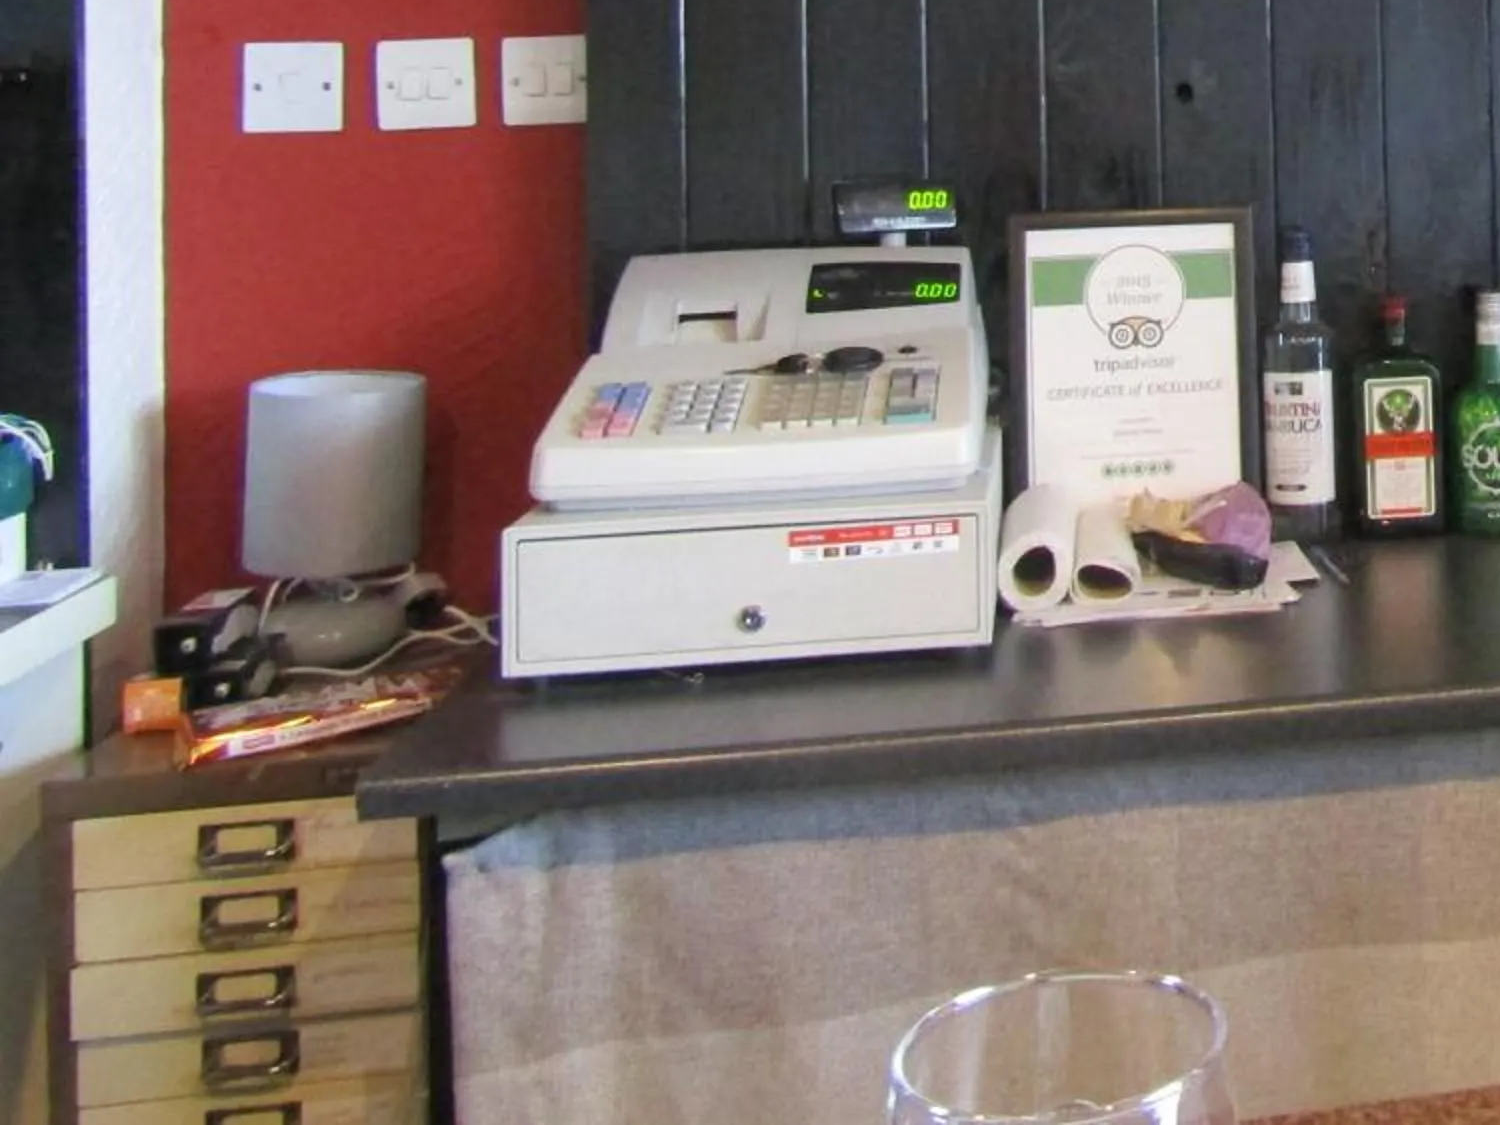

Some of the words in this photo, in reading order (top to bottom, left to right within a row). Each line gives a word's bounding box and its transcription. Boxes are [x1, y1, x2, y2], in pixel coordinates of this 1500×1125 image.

[1093, 356, 1175, 373] tripadvisor
[1046, 384, 1125, 402] CERTIFICATE
[1146, 379, 1223, 396] EXCELLENCE
